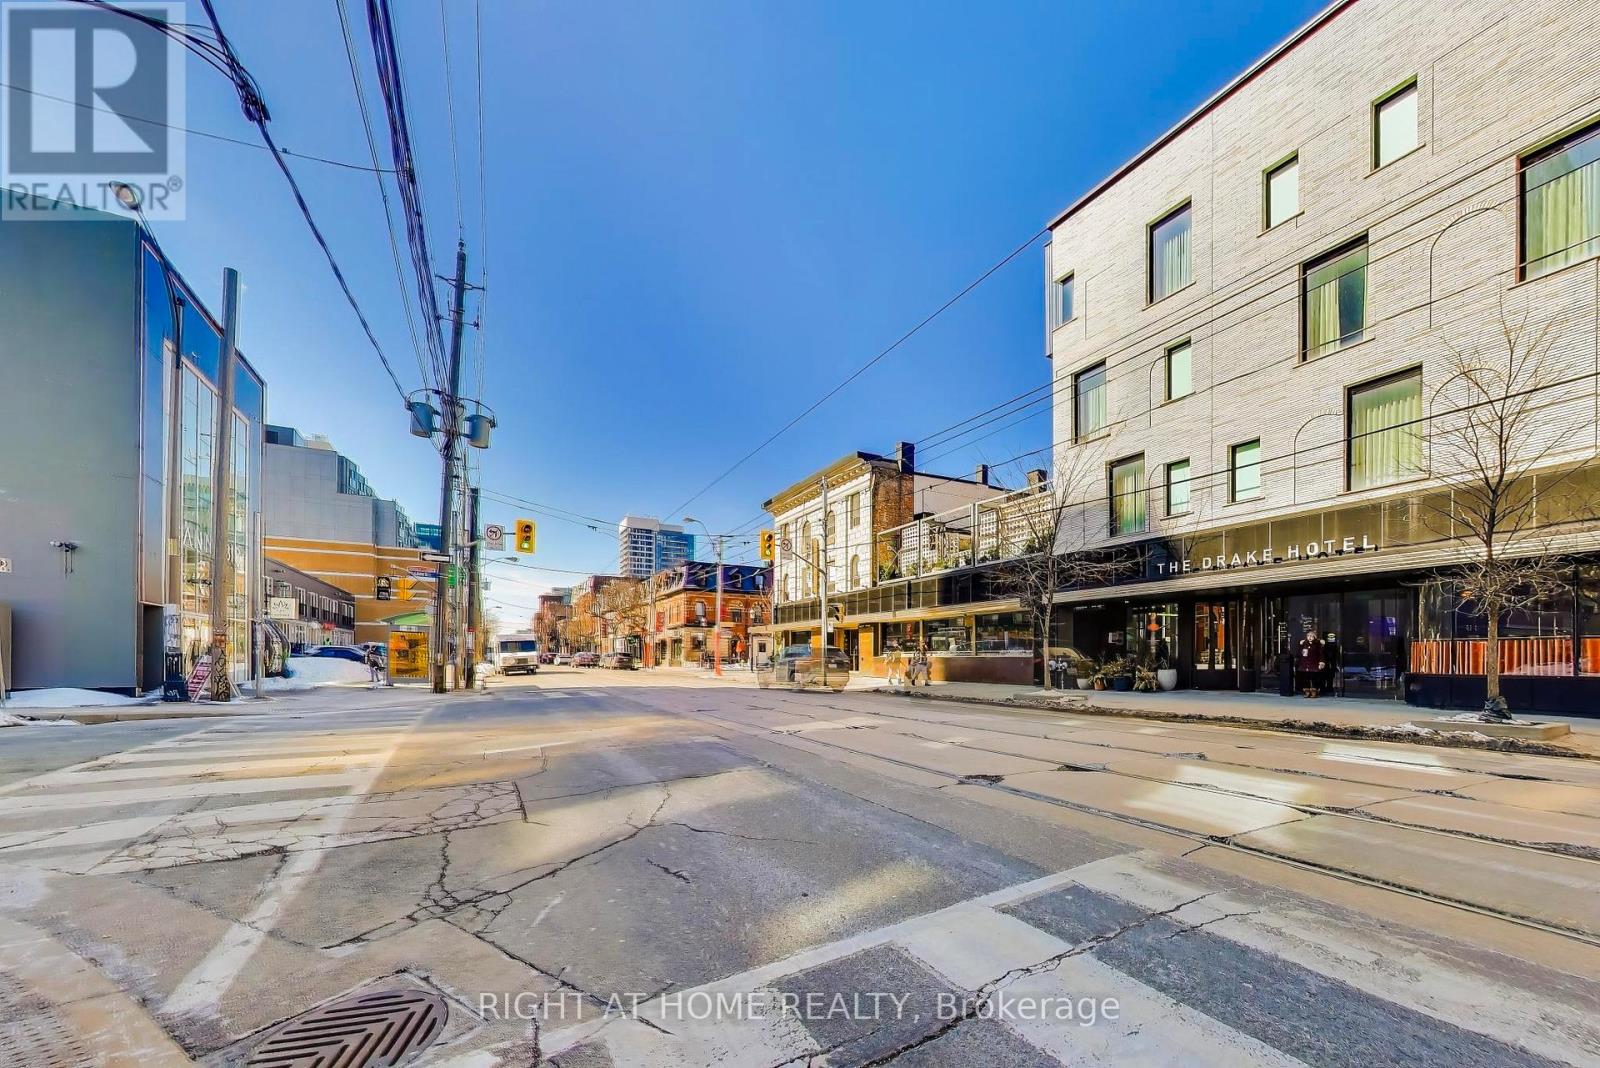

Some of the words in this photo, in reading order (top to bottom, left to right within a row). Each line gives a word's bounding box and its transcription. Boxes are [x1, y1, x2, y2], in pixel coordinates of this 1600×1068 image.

[1157, 560, 1191, 575] THE
[1202, 548, 1272, 569] DRAKE
[1288, 535, 1376, 560] HOTEL
